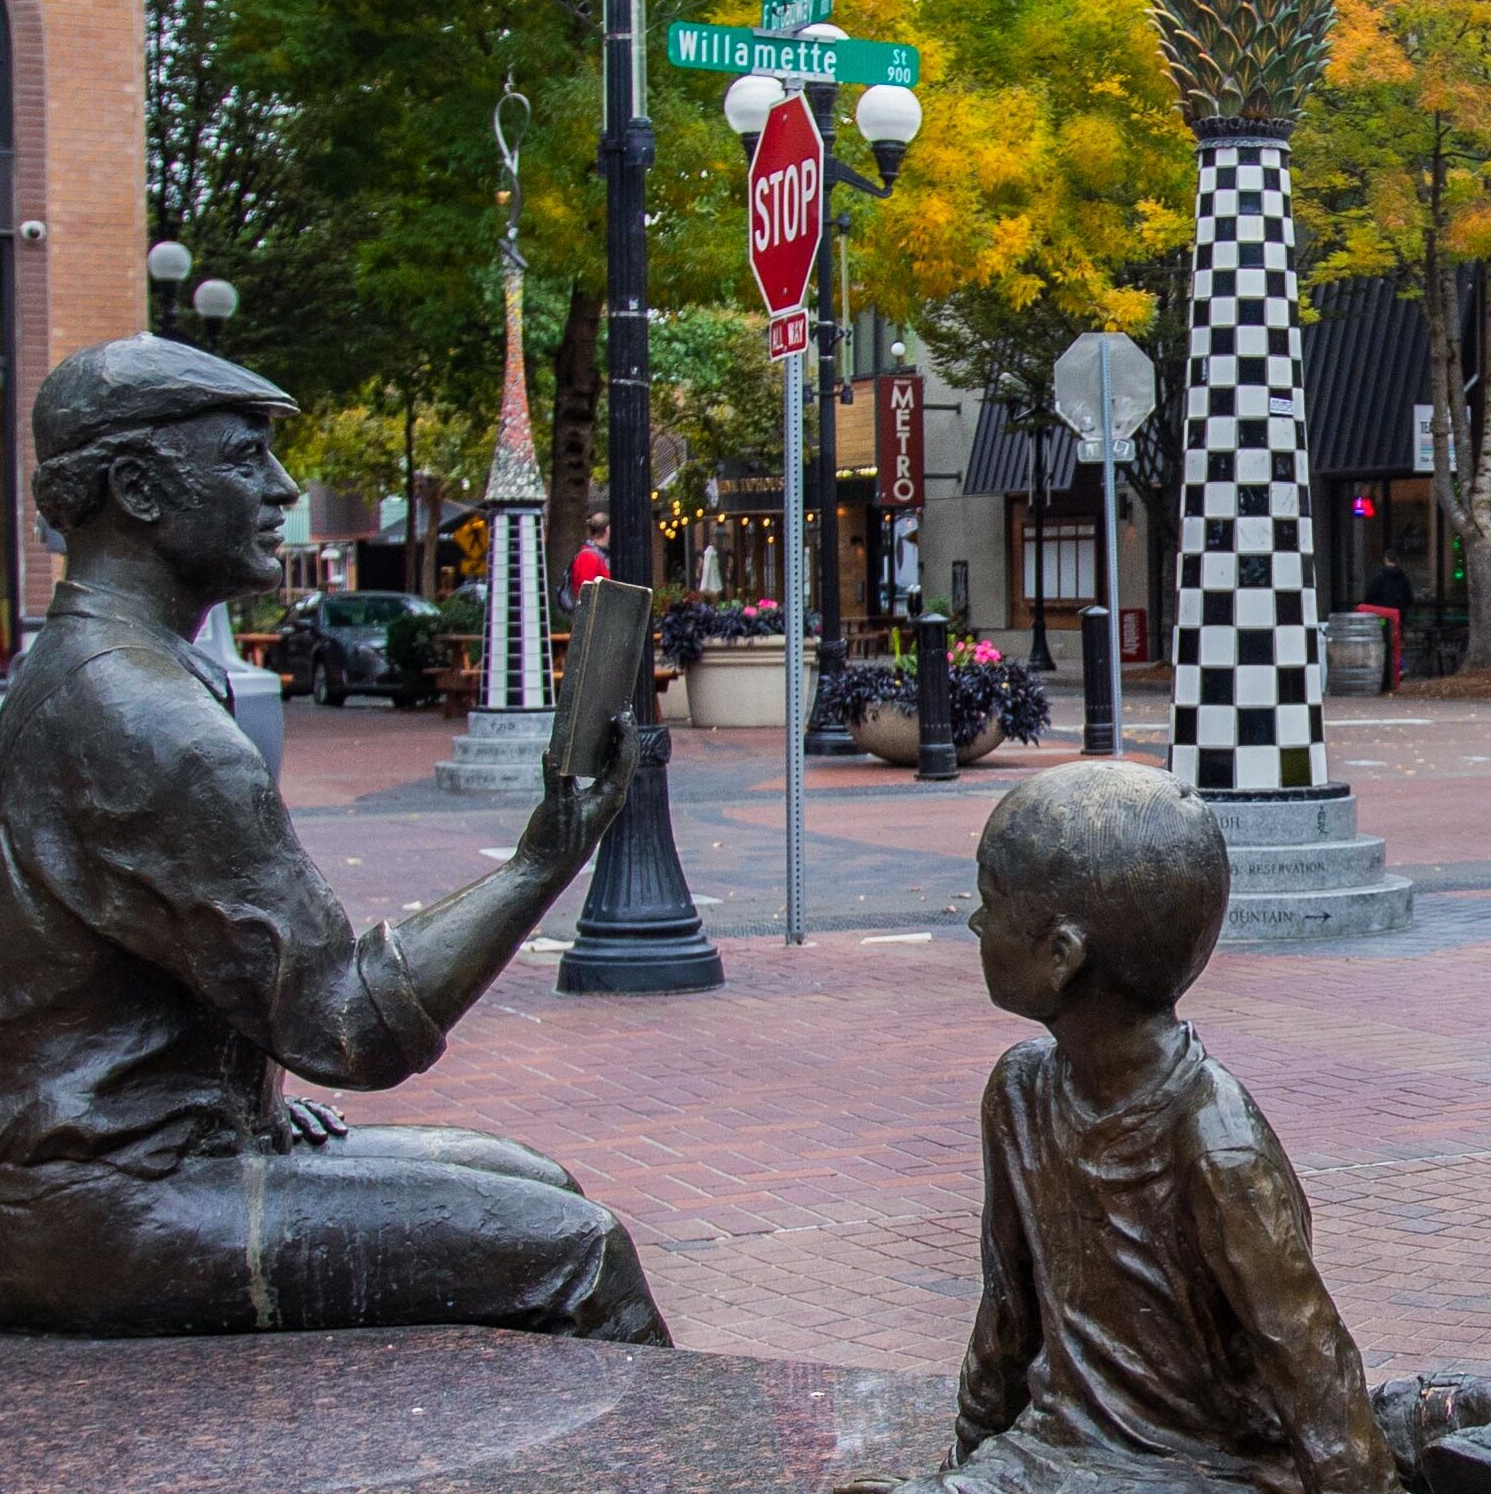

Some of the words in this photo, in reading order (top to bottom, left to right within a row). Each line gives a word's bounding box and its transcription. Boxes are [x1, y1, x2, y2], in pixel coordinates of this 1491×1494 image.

[678, 29, 837, 75] Willamette
[892, 48, 908, 65] St
[887, 66, 911, 83] 900
[754, 157, 817, 252] STOP
[787, 318, 805, 346] WAY
[890, 380, 915, 501] METRO
[1249, 862, 1325, 877] RESERVATION
[1228, 910, 1293, 924] OUNTAIN
